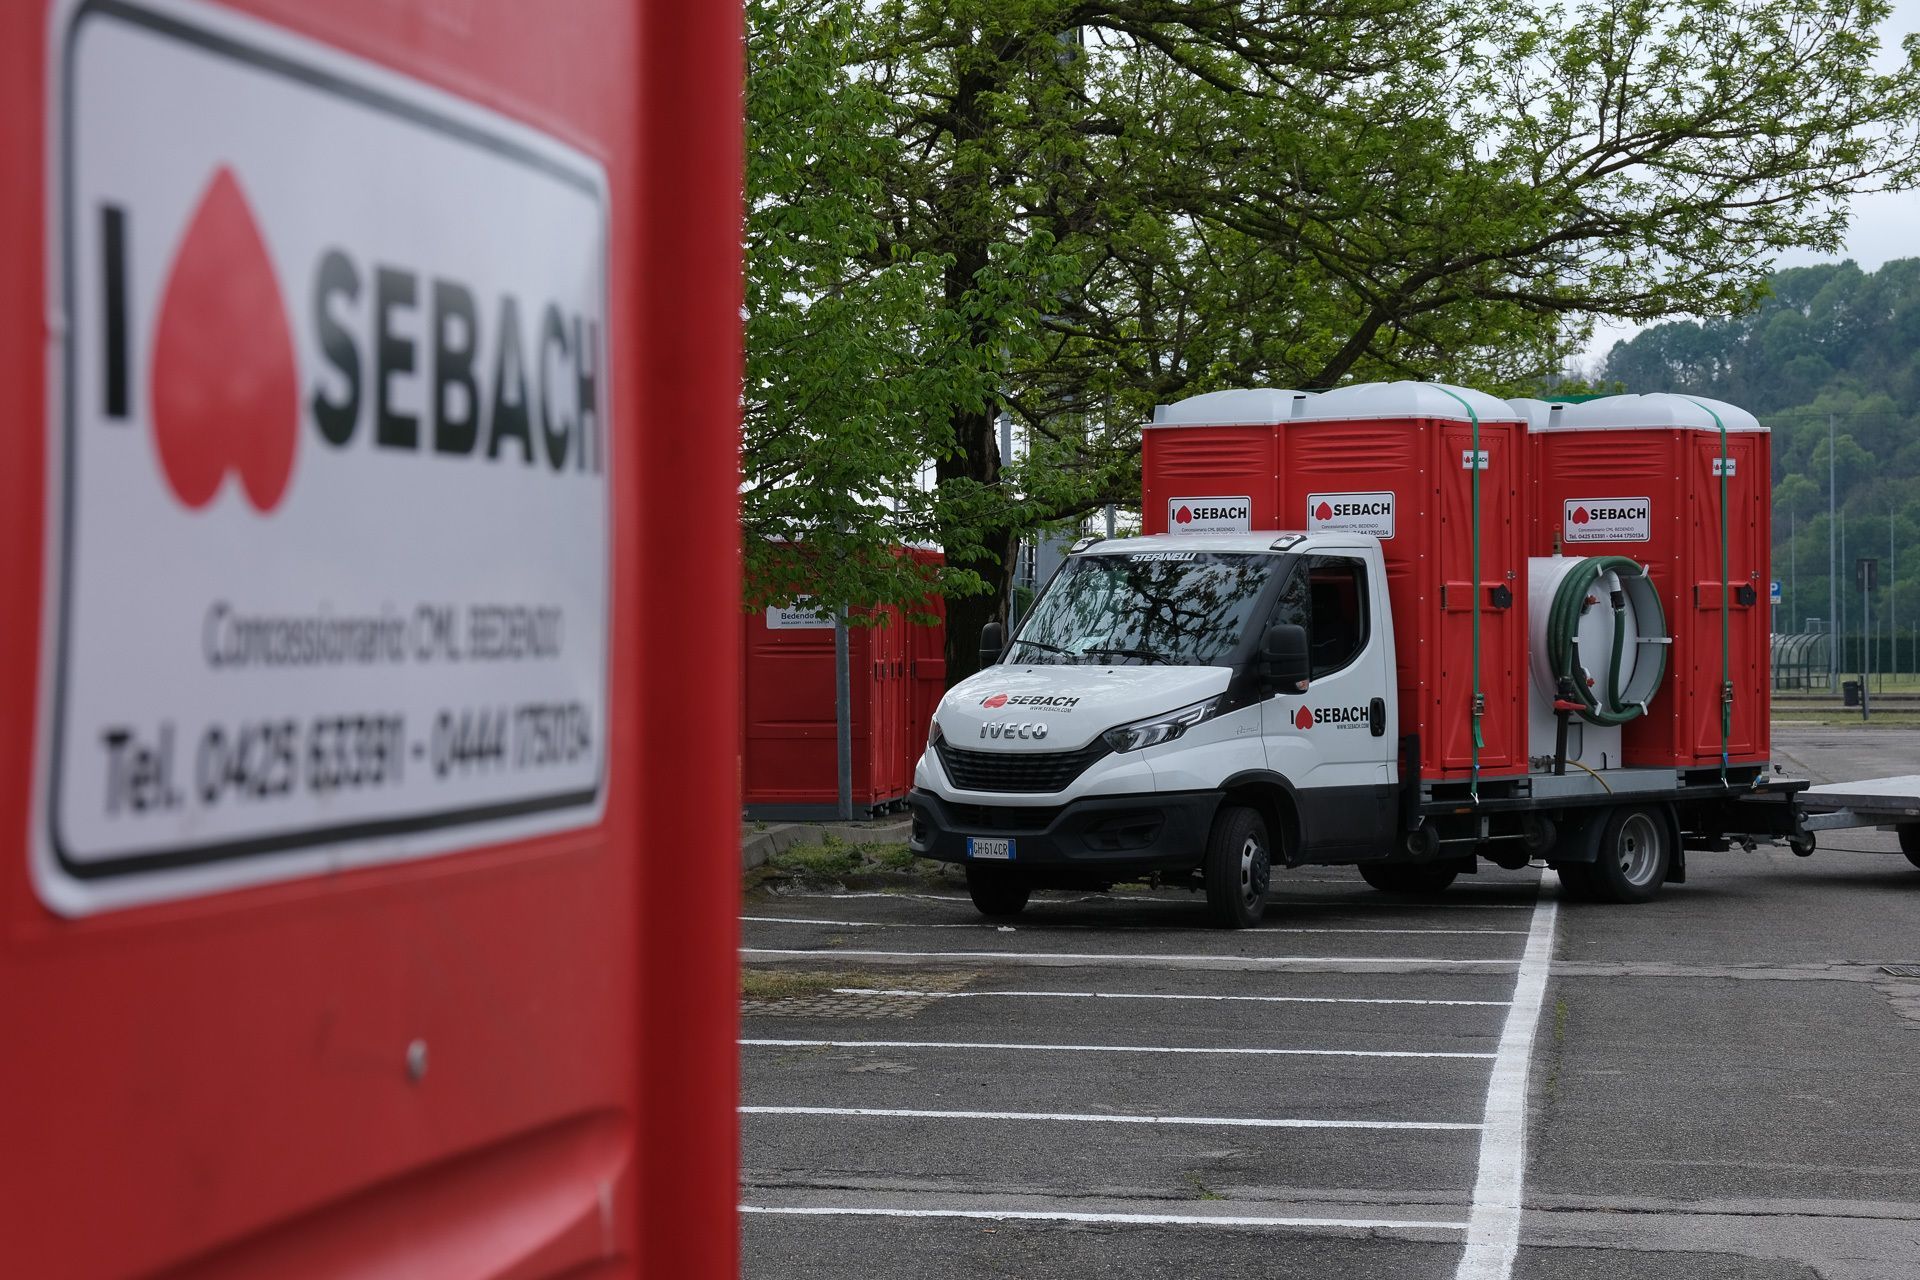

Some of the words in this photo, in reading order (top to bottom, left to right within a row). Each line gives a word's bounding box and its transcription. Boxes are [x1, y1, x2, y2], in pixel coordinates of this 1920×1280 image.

[100, 199, 131, 420] I
[309, 247, 604, 477] SEBACH
[1172, 508, 1175, 520] I
[1193, 507, 1247, 520] SEBACH
[1311, 505, 1314, 516] I
[1334, 503, 1390, 516] SEBACH
[1568, 510, 1572, 520] I
[1590, 508, 1646, 520] SEBACH
[1130, 552, 1197, 562] STEFANELLI
[1007, 696, 1080, 706] SEBACH
[1290, 710, 1294, 724] I
[1314, 706, 1368, 723] SEBACH
[980, 722, 1048, 740] IVECO
[100, 715, 182, 820] Tel.
